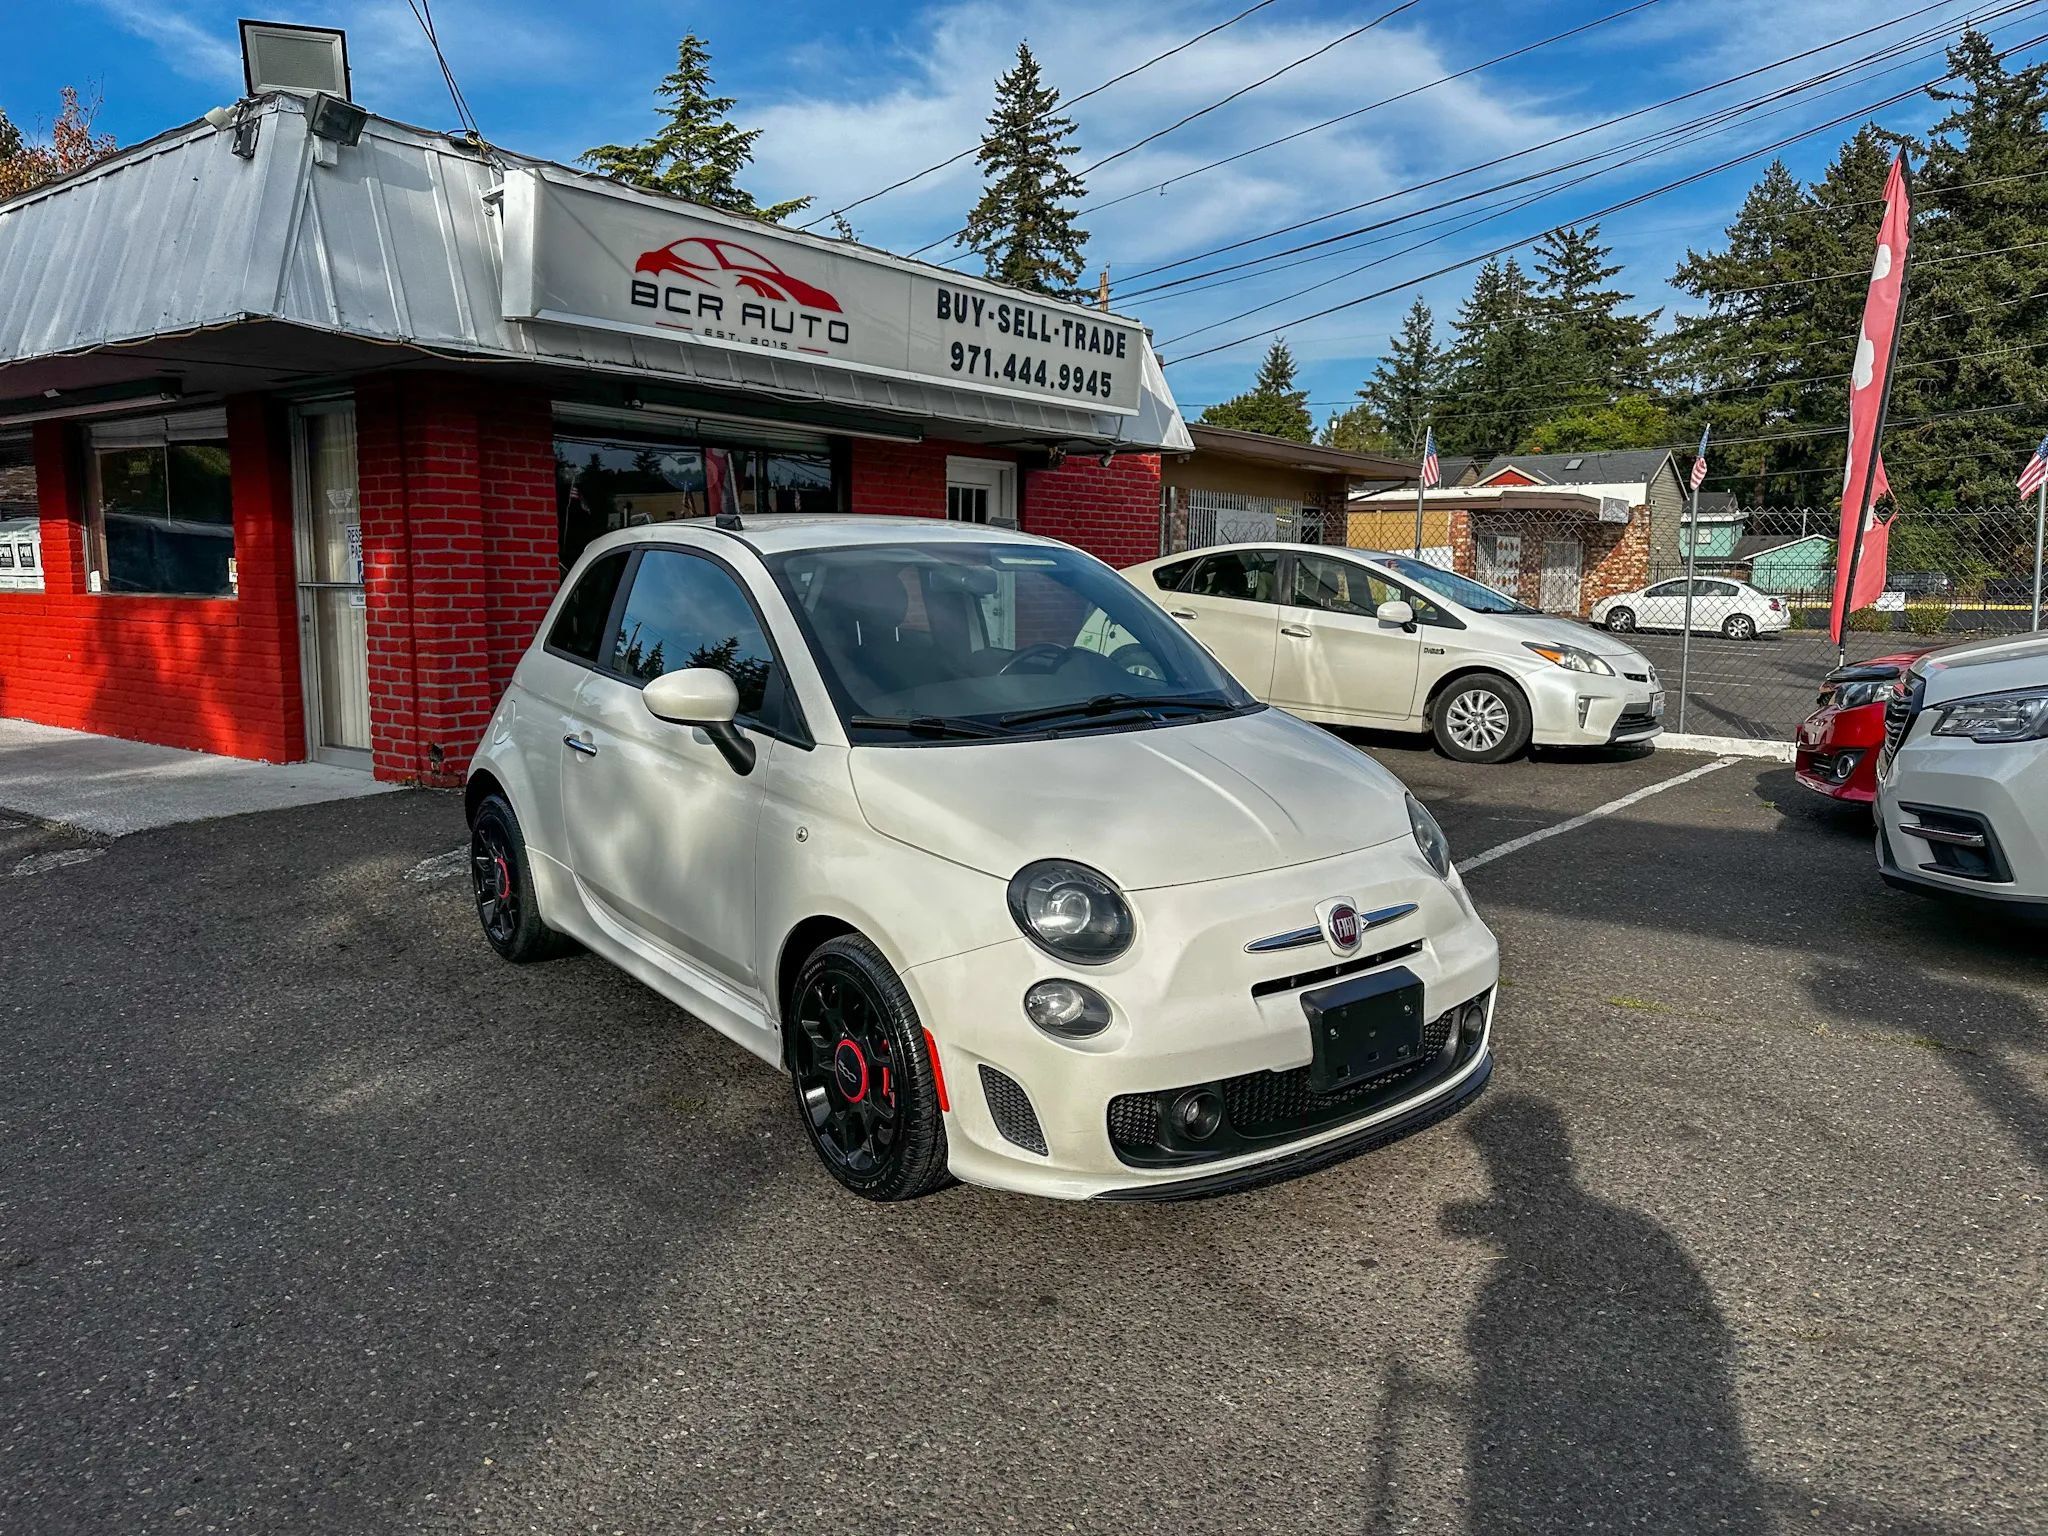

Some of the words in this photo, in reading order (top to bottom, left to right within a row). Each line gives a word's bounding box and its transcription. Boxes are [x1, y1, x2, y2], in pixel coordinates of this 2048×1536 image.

[631, 279, 723, 321] BCR
[742, 302, 849, 344] AUTO
[704, 328, 741, 342] EST.
[750, 336, 789, 350] 2015
[950, 341, 1112, 398] 971.444.9945
[1336, 915, 1356, 938] FIAT
